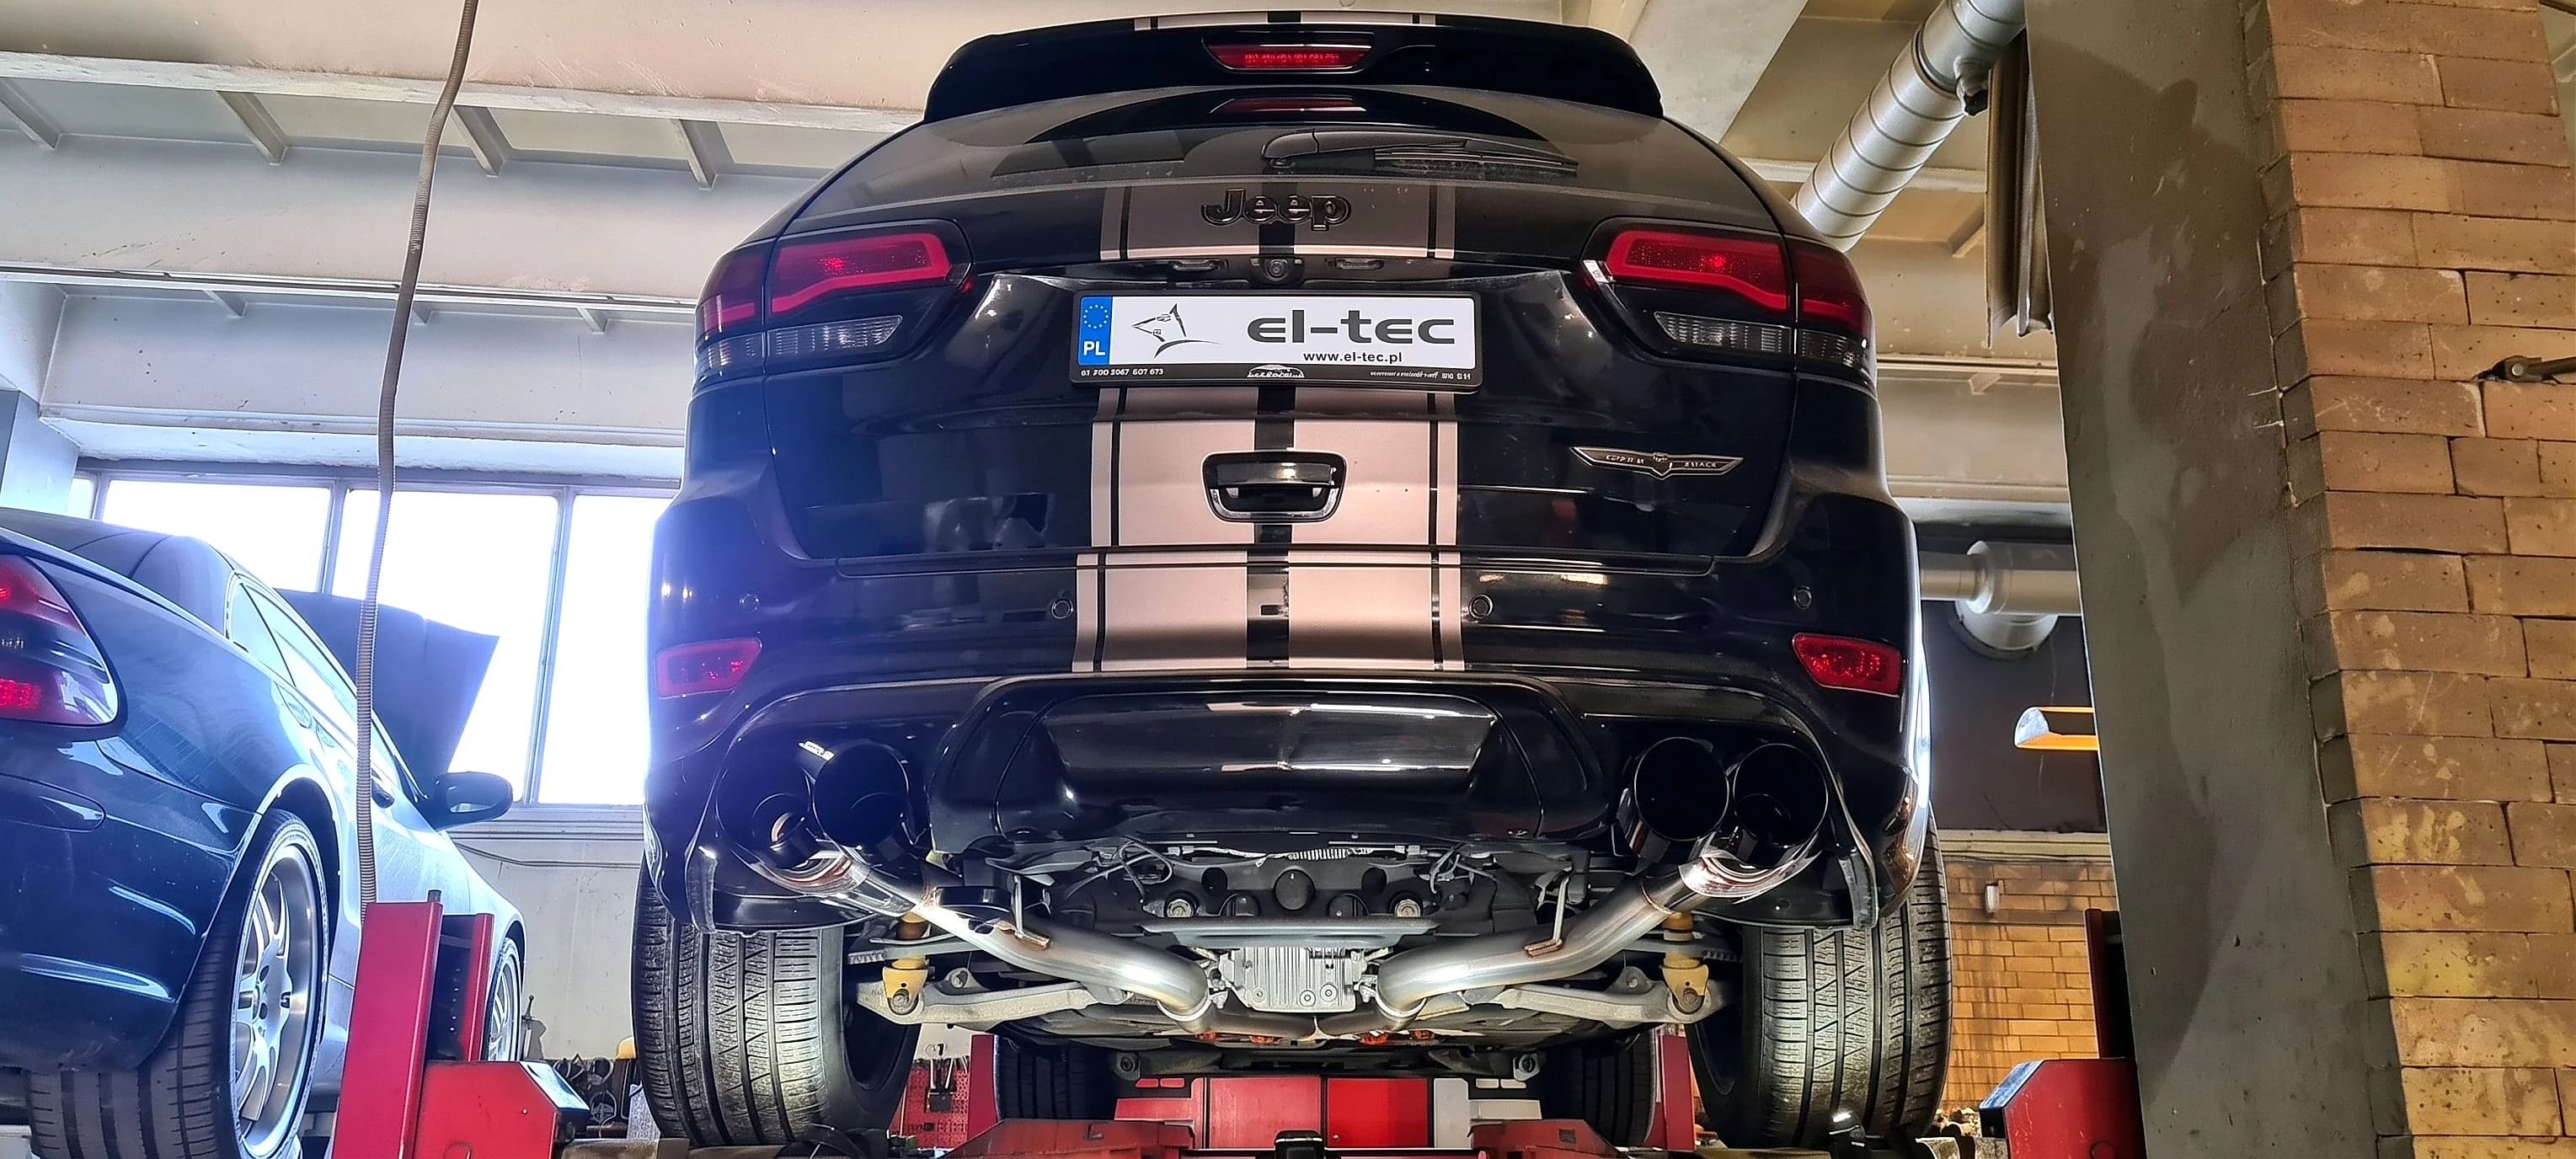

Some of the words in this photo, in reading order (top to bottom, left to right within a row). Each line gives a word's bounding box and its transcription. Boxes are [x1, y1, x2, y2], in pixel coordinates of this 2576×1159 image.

[1201, 188, 1351, 232] Jeep
[1247, 309, 1455, 344] el-tec
[1082, 340, 1106, 356] PL
[1303, 352, 1403, 364] www.el-tec.pl
